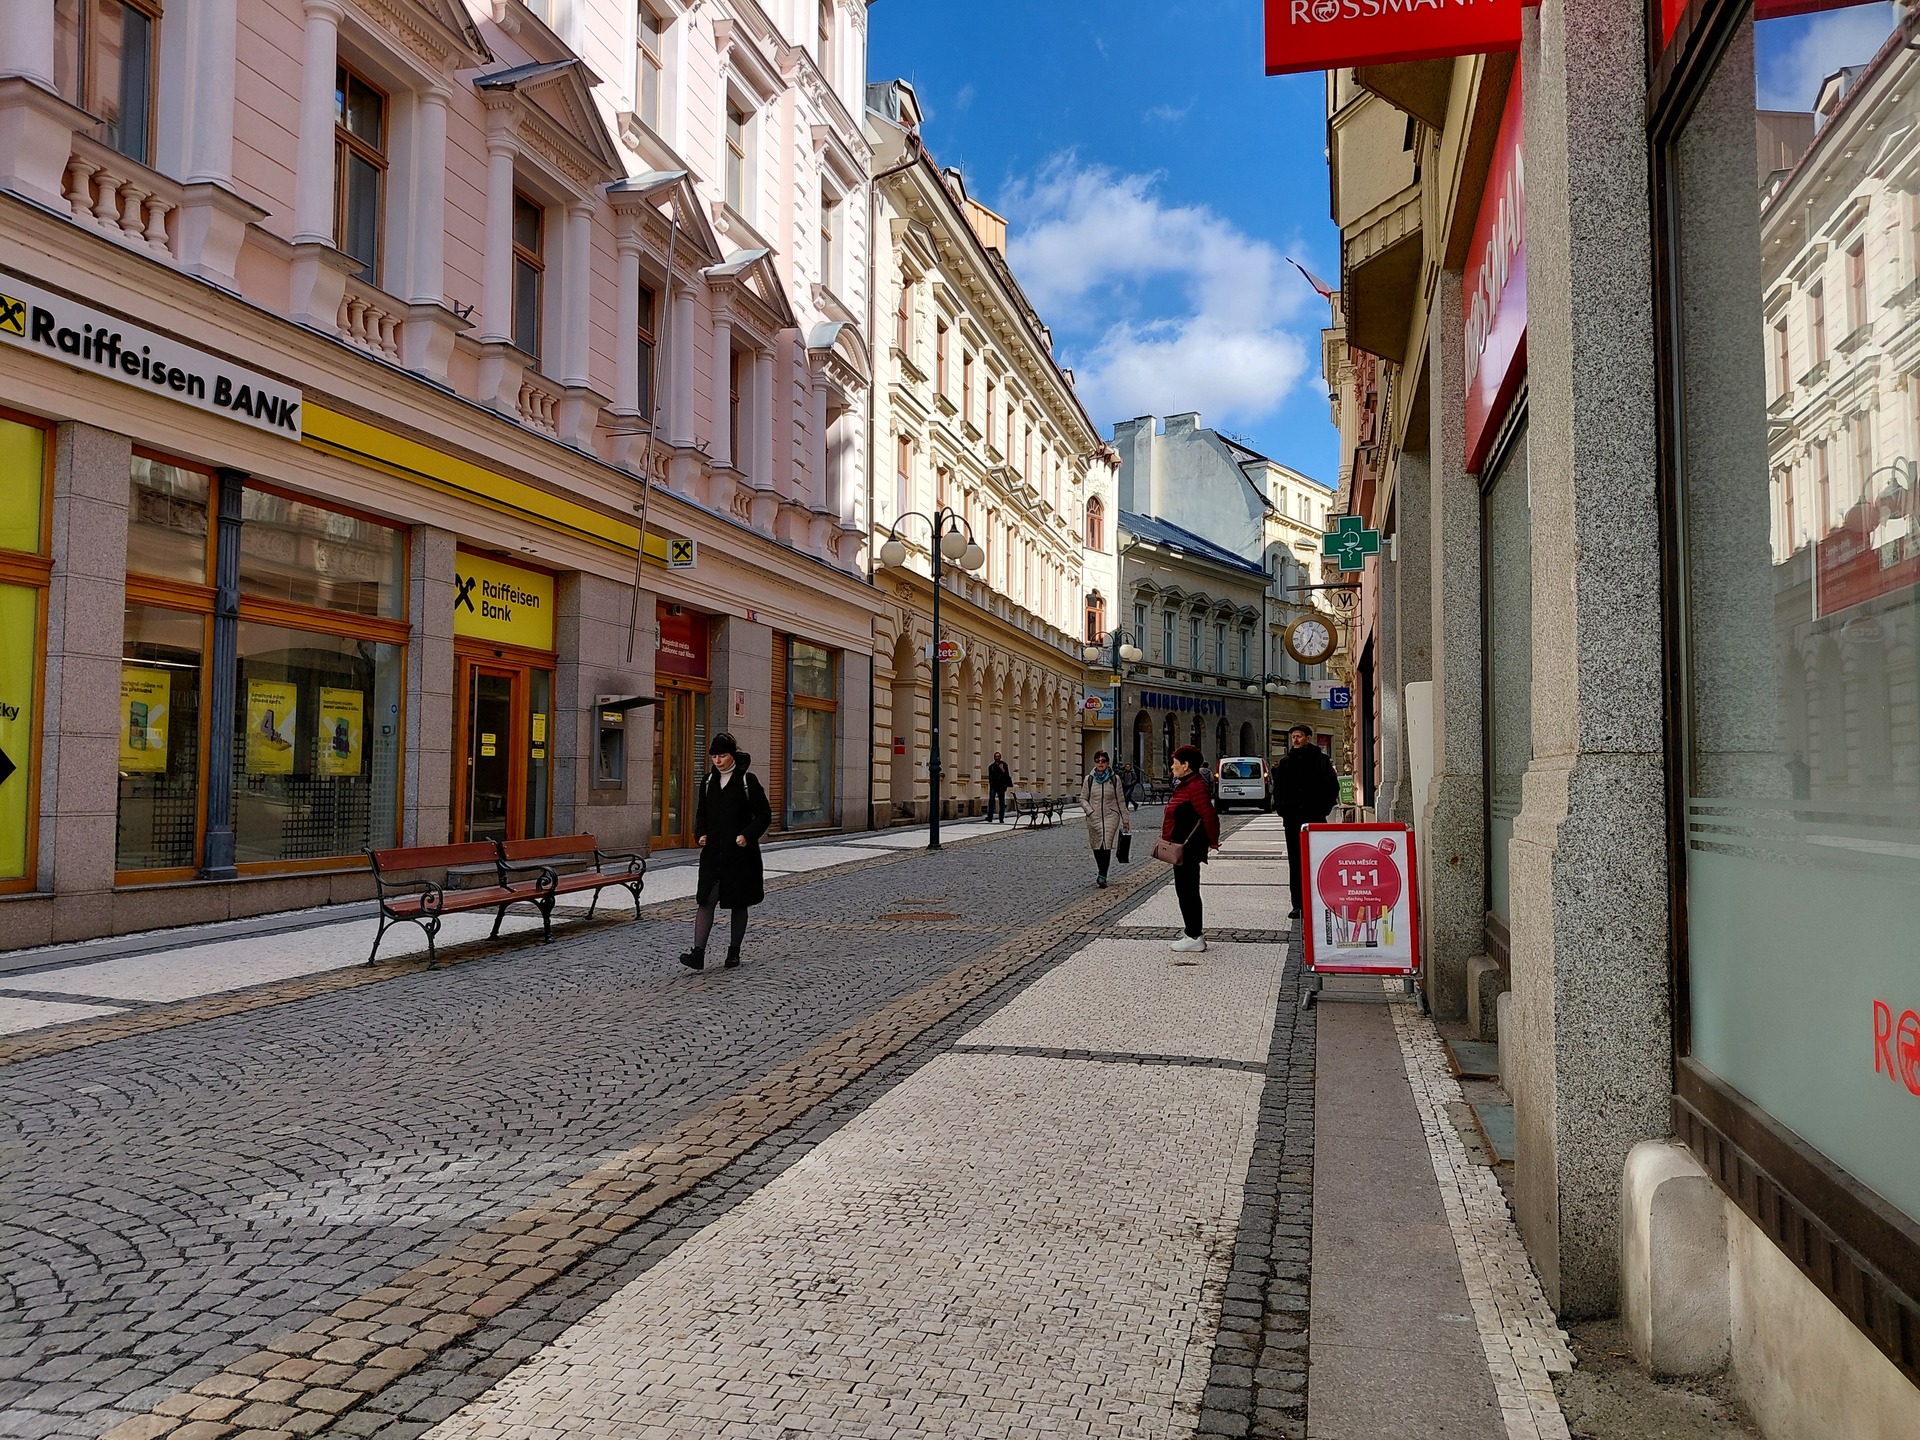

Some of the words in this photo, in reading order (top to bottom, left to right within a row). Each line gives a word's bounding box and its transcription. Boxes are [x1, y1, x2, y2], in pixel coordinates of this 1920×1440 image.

[32, 305, 206, 400] Raiffeisen
[213, 375, 300, 432] BANK
[482, 579, 540, 609] Raiffeisen
[481, 600, 512, 623] Bank
[938, 649, 958, 657] teta
[1333, 689, 1349, 704] bs
[1357, 858, 1378, 866] MĚSÍCE
